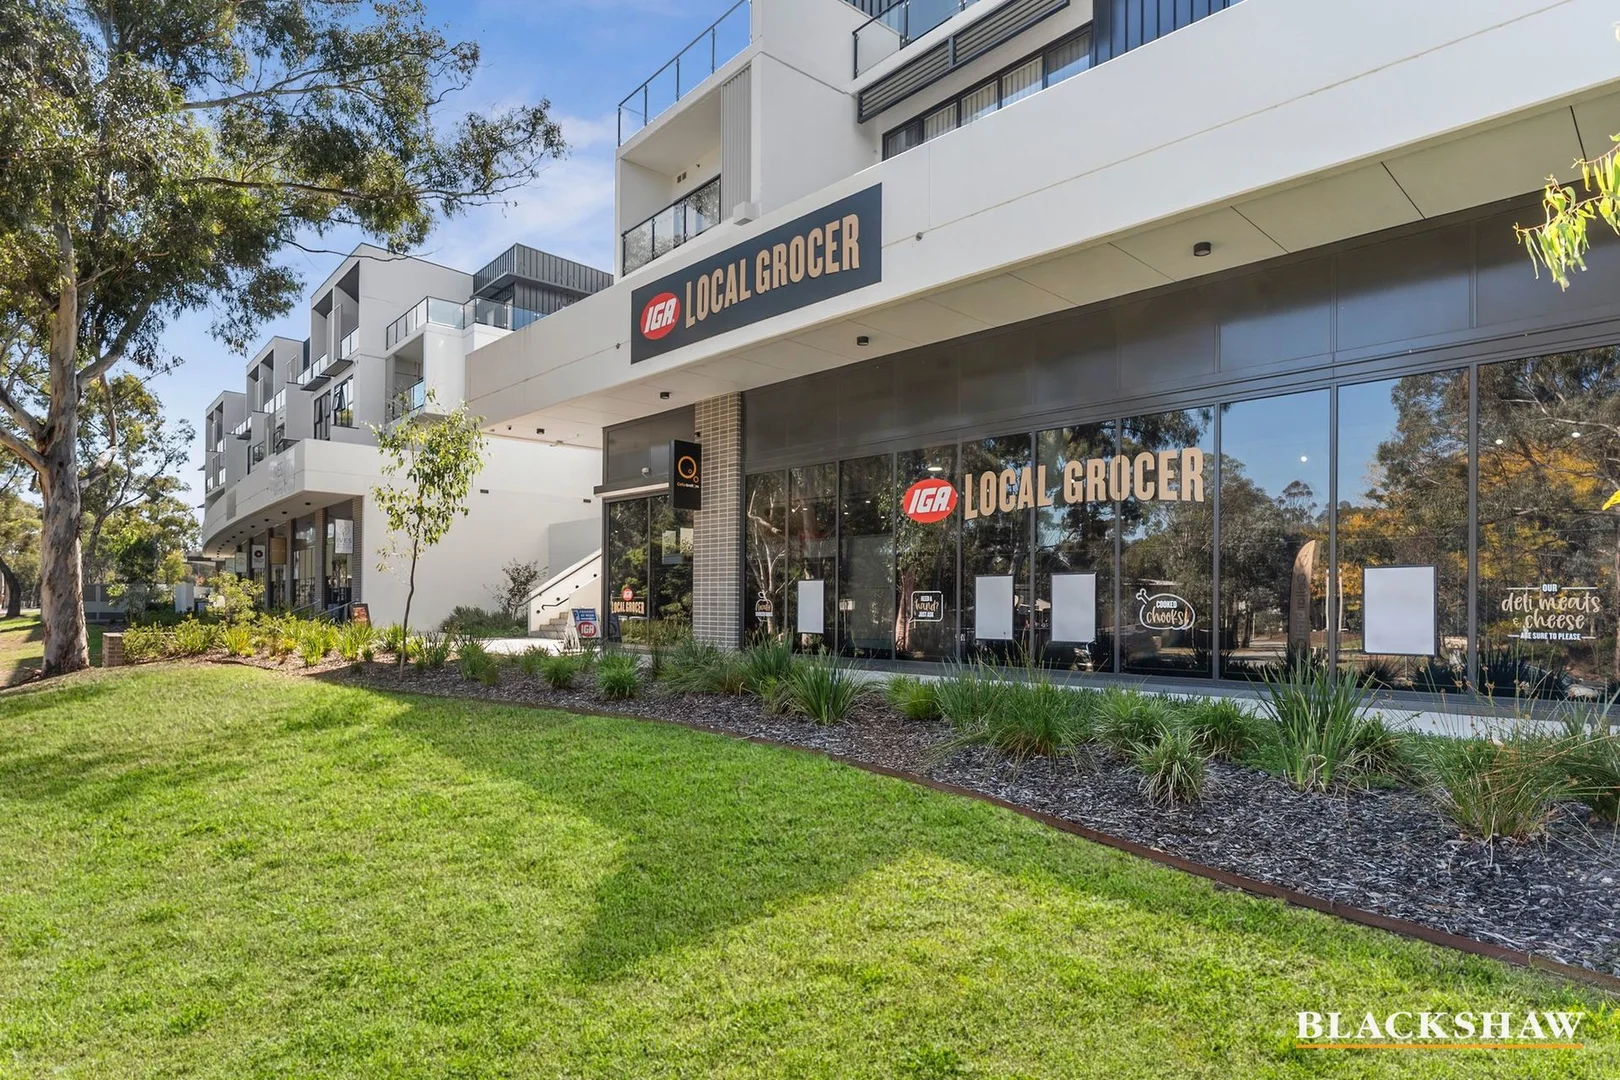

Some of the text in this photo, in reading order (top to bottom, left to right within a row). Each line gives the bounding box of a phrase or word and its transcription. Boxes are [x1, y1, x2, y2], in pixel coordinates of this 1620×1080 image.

[644, 213, 860, 333] IGA LOCAL GROCER
[908, 446, 1204, 520] IGA LOCAL GROCER
[1542, 584, 1558, 592] OUR
[611, 601, 644, 614] LOCAL GROCER
[1501, 592, 1601, 613] deli meats
[1523, 609, 1585, 631] cheese
[581, 624, 594, 634] IGA
[1558, 633, 1581, 641] PLEASE
